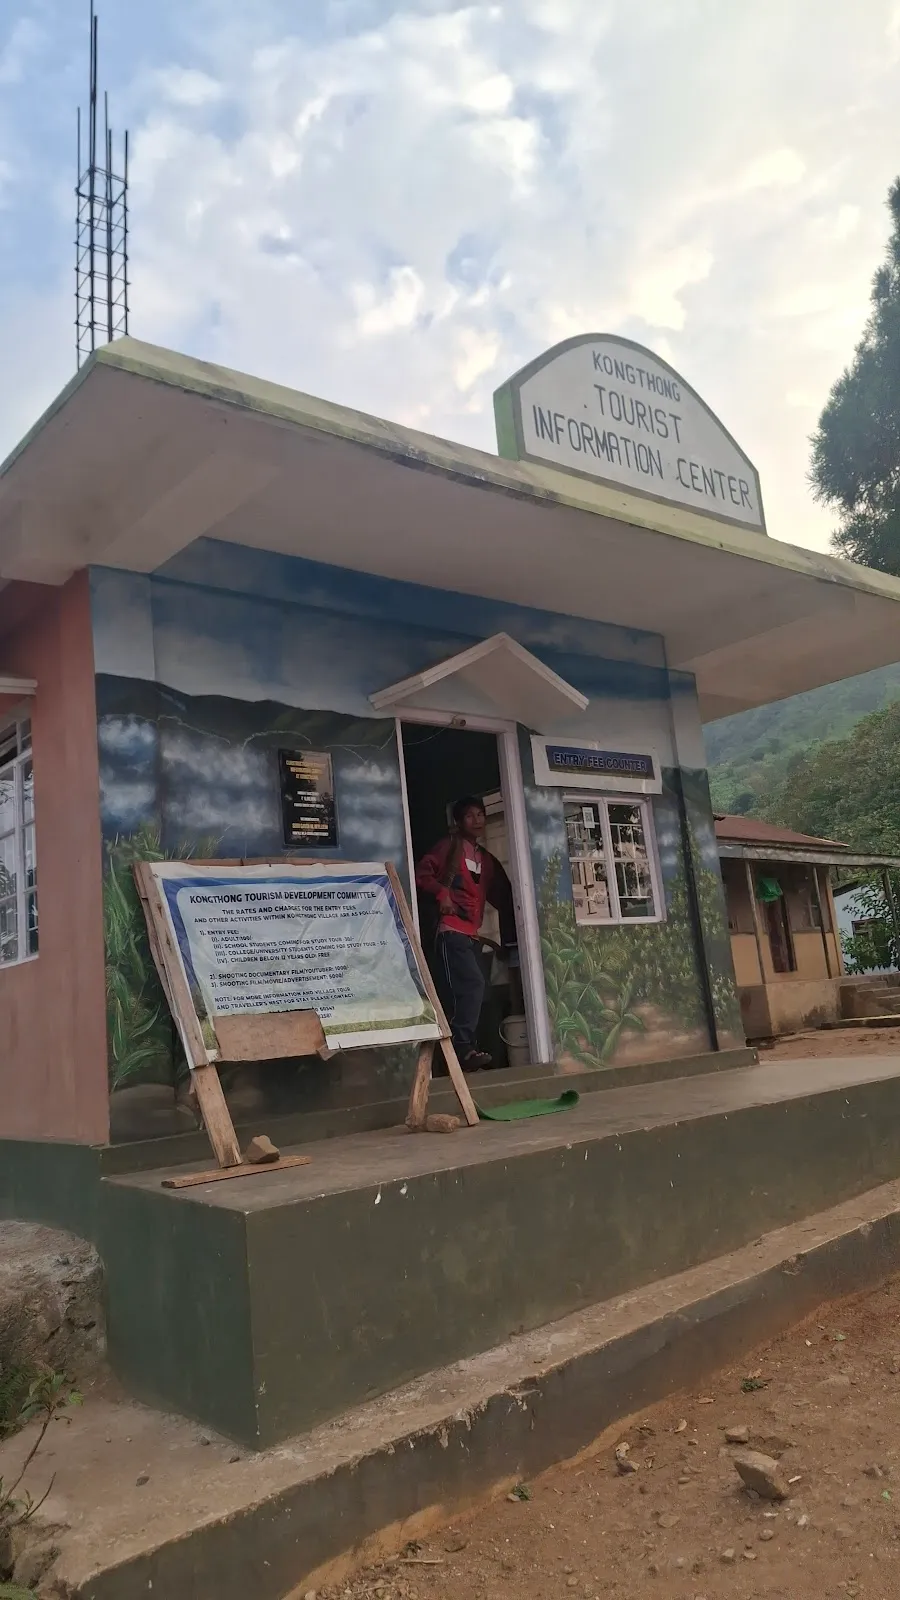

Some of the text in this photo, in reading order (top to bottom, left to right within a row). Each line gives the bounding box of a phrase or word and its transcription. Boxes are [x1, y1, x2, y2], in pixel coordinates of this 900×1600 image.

[592, 350, 681, 402] KONGTHONG
[593, 384, 682, 444] TOURIST
[532, 404, 753, 509] INFORMATION CENTER
[553, 752, 648, 773] ENTRY FEE COUNTER
[190, 891, 377, 903] KONGTHONG TOURISM DEVELOPMENT COMMITTEE
[230, 915, 261, 923] ACTIVITIES
[249, 940, 278, 948] STUDENTS
[289, 945, 314, 953] STUDENTS
[230, 955, 257, 963] CHILDREN
[259, 954, 280, 962] BELOW
[218, 972, 247, 980] SHOOTING
[248, 970, 290, 978] DOCUMENTARY
[219, 979, 249, 988] SHOOTING
[263, 990, 301, 999] INFORMATION
[216, 1002, 230, 1010] AND
